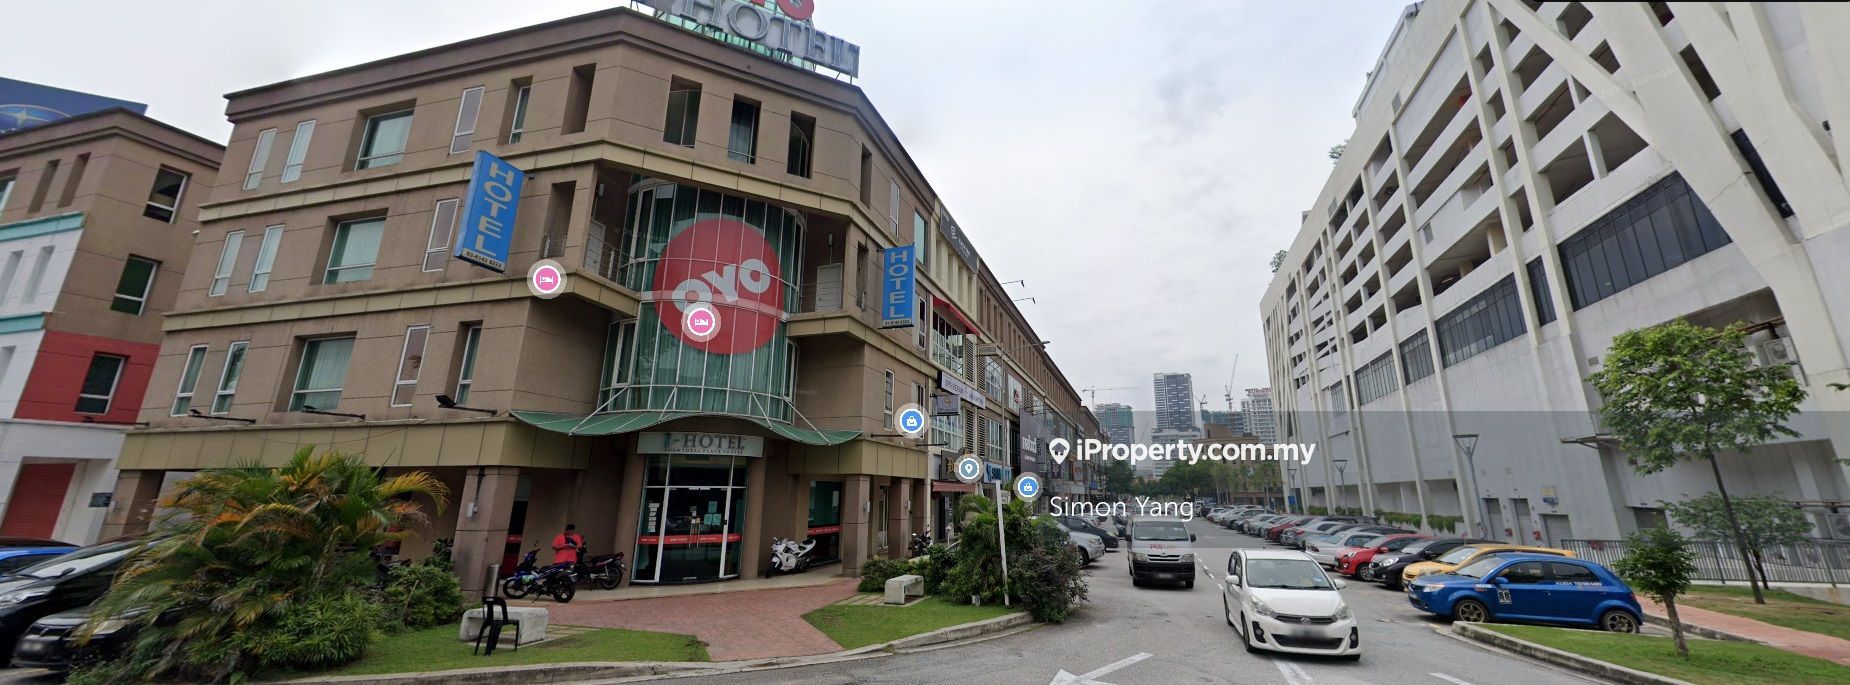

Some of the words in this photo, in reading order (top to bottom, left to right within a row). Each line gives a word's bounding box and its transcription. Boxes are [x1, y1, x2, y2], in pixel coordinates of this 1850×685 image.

[679, 0, 858, 77] HOTEL
[475, 161, 514, 257] HOTEL
[672, 258, 770, 317] OYO
[889, 250, 908, 317] HOTEL
